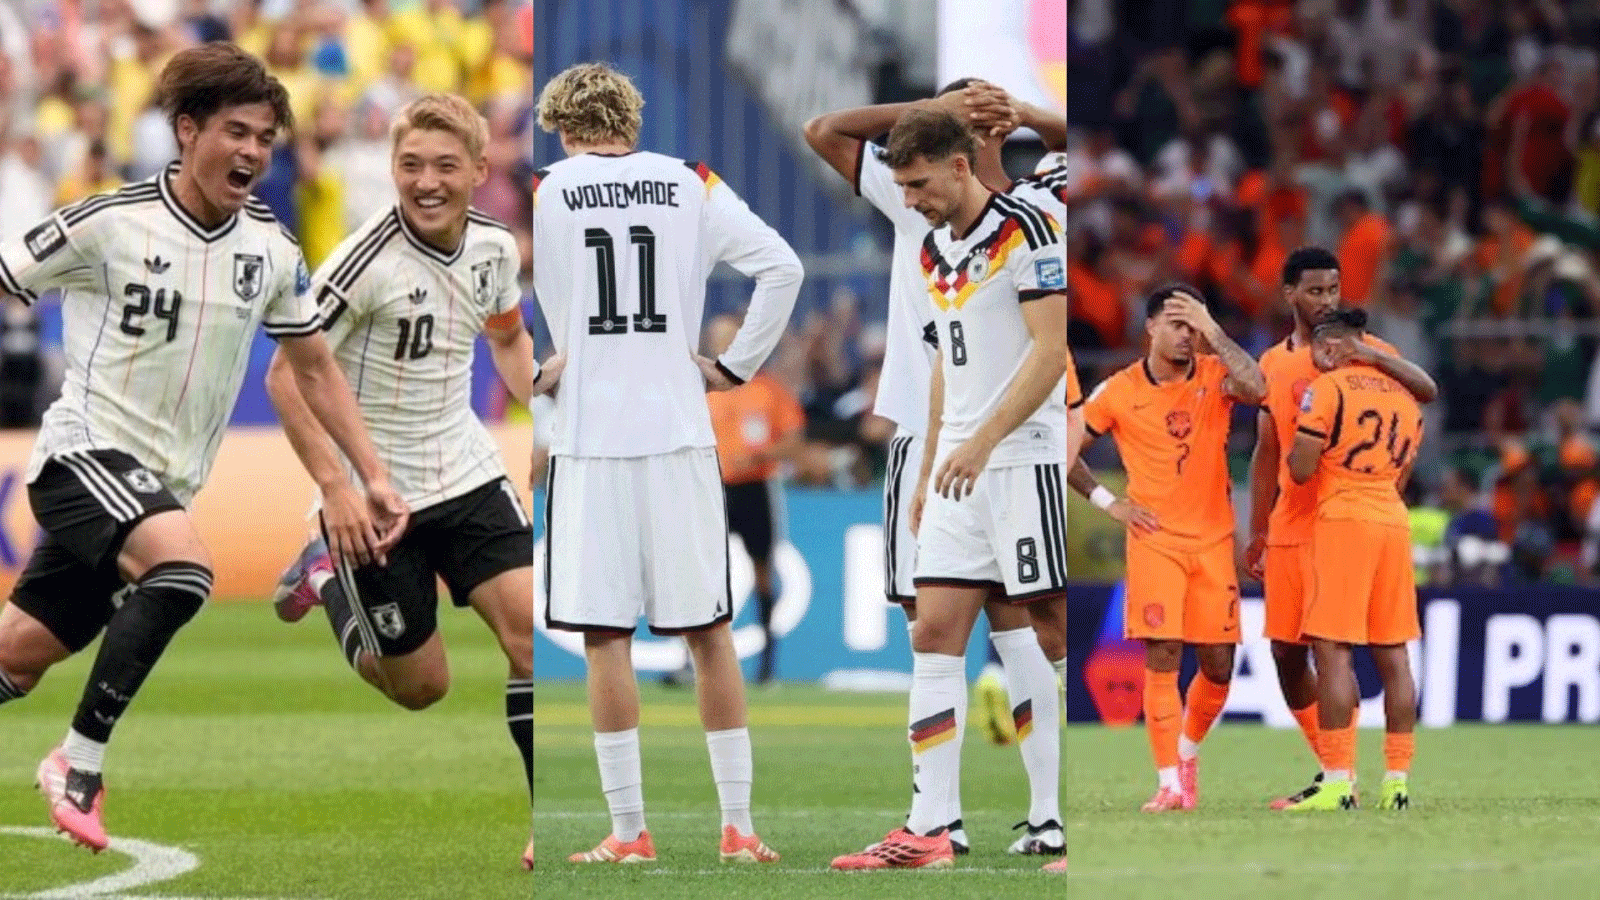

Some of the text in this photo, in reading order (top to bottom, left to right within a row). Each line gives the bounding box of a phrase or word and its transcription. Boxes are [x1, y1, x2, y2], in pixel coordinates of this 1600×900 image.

[562, 180, 680, 212] WOLTEMADE
[584, 225, 668, 336] 11
[119, 282, 182, 343] 24
[394, 314, 434, 361] 10
[949, 320, 968, 367] 8
[1175, 442, 1191, 475] 7
[1342, 408, 1412, 475] 24
[1015, 536, 1040, 584] 8
